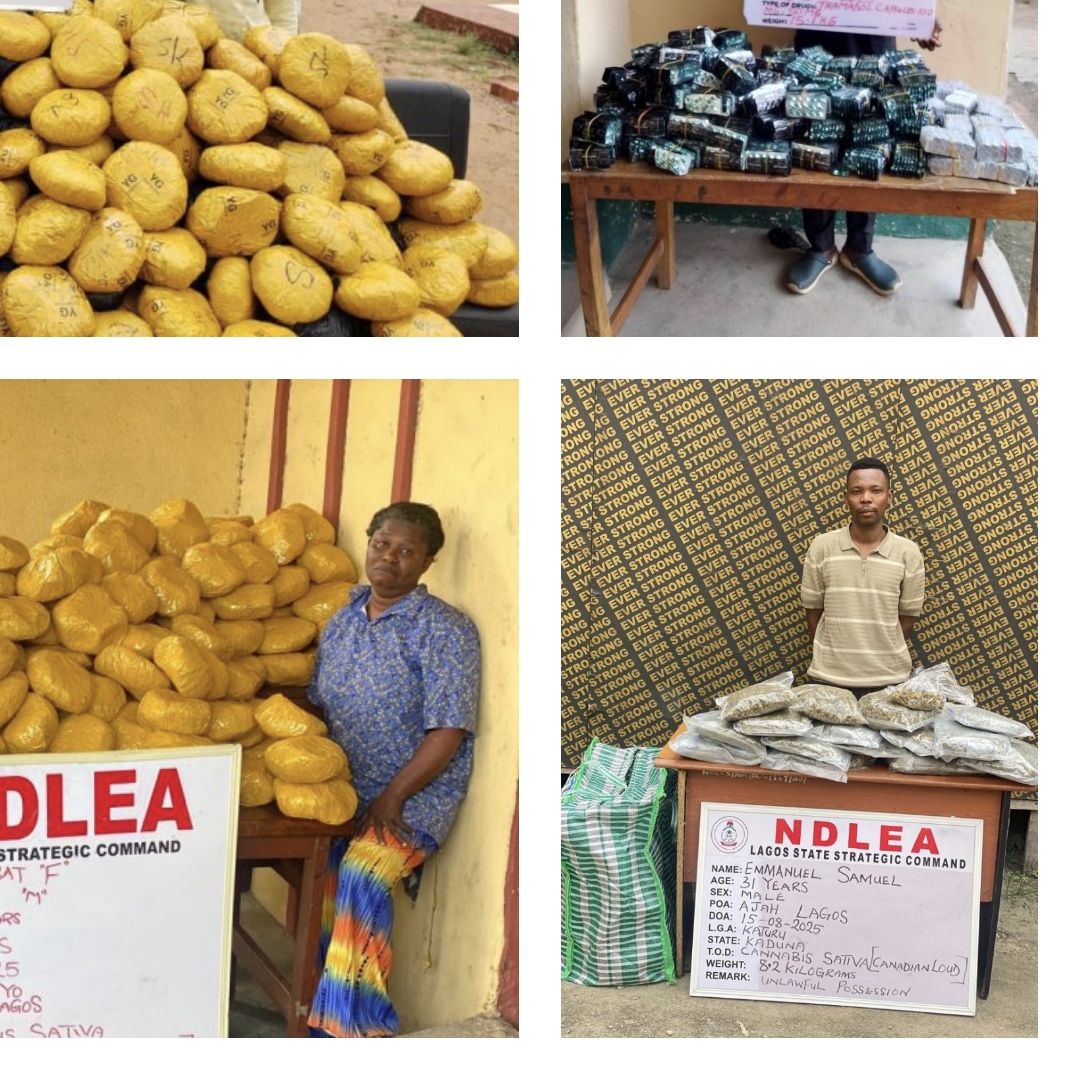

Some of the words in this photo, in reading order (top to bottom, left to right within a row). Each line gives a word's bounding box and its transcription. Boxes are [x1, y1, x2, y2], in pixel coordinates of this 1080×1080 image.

[644, 453, 677, 477] EVER
[677, 426, 727, 459] STRONG
[650, 465, 683, 488] EVER
[683, 437, 733, 470] STRONG
[946, 444, 998, 478] STRONG
[656, 476, 689, 499] EVER
[689, 449, 738, 481] STRONG
[904, 462, 938, 486] EVER
[774, 818, 940, 855] NDLEA
[95, 840, 181, 857] COMMAND
[750, 845, 790, 858] LAGOS
[793, 848, 830, 860] STATE
[833, 851, 902, 865] STRATEGIC
[905, 855, 967, 870] COMMAND
[711, 864, 742, 875] NAME:
[744, 862, 822, 880] EMMANUEL
[838, 866, 902, 887] SAMUEL
[710, 876, 735, 885] AGE:
[740, 877, 755, 889] 31
[762, 876, 809, 893] YEARS
[710, 888, 732, 897] SEX:
[740, 891, 785, 902] MALE
[709, 900, 733, 909] POA:
[739, 901, 780, 915] AJAH
[796, 905, 848, 924] LAGOS
[708, 911, 733, 921] DOA:
[708, 923, 737, 934] L.G.A:
[707, 935, 740, 946] STATE:
[745, 937, 805, 951] KADUNA
[706, 947, 735, 957] T.O.D:
[740, 946, 813, 965] CANNABIS
[705, 959, 747, 970] WEIGHT:
[785, 963, 857, 980] KILOGRAMS
[705, 971, 750, 982] REMARK:
[761, 975, 825, 992] UNLAWFUL
[836, 980, 911, 997] POSSESSION
